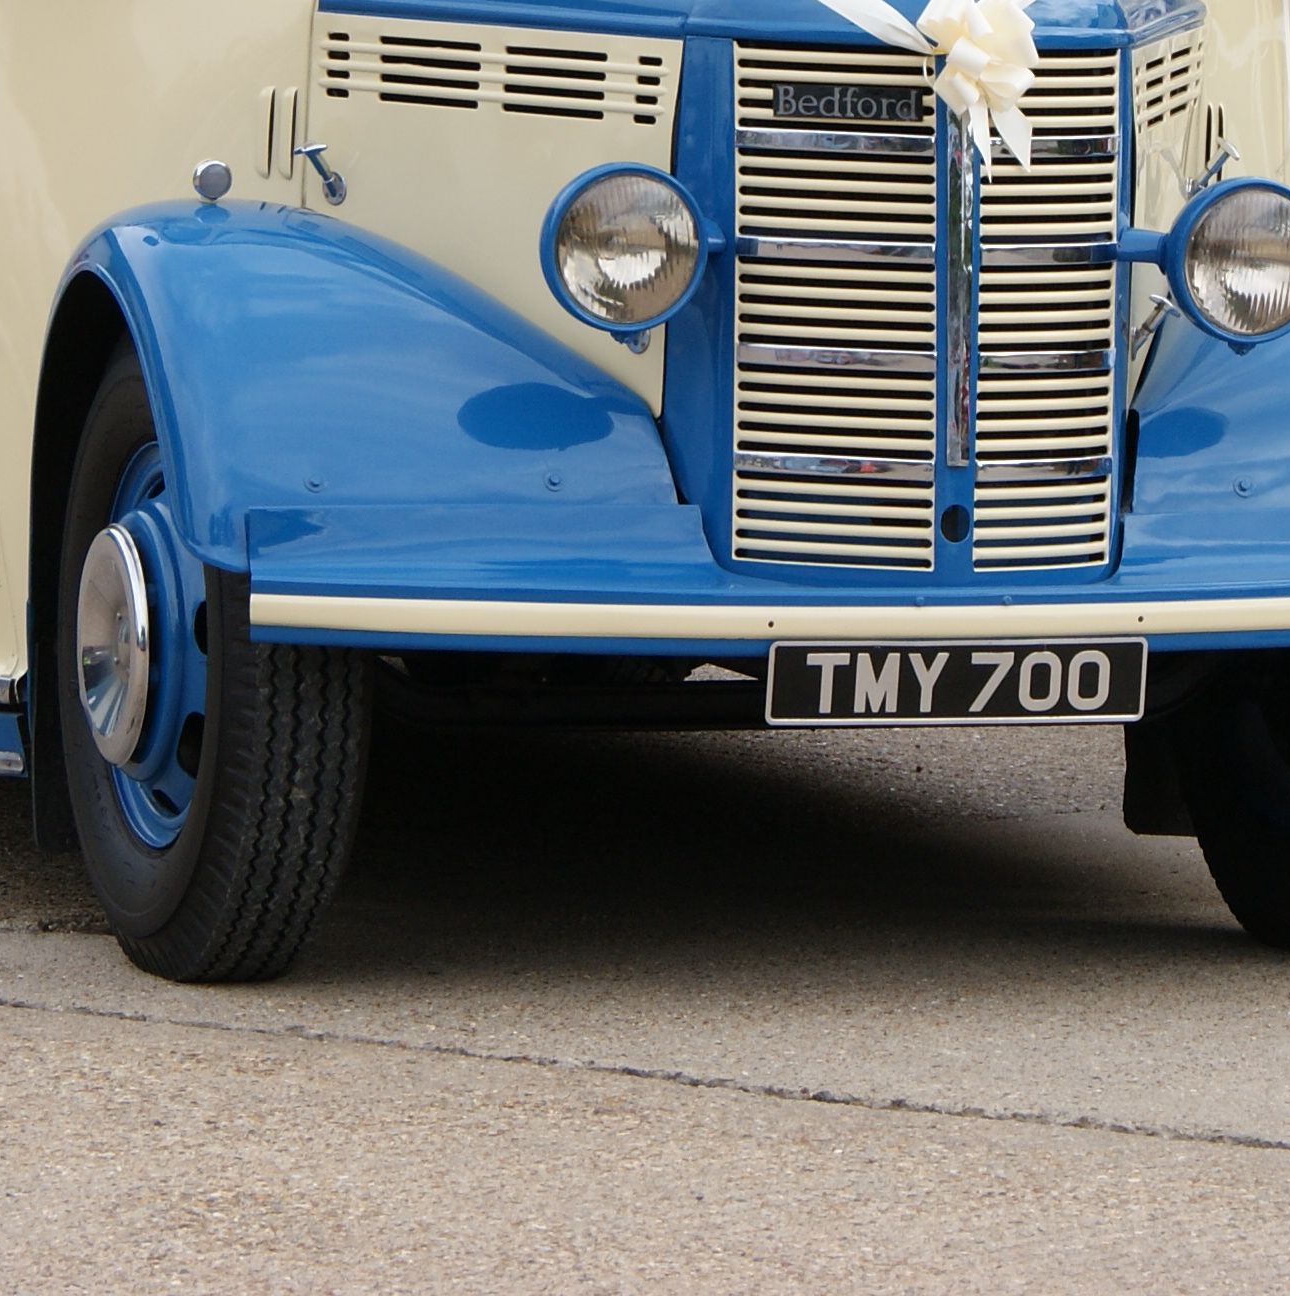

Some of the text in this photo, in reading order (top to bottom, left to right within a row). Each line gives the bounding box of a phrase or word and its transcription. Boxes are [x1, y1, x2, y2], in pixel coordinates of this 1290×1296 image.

[775, 85, 918, 121] Bedford
[806, 650, 1111, 714] TMY 700
